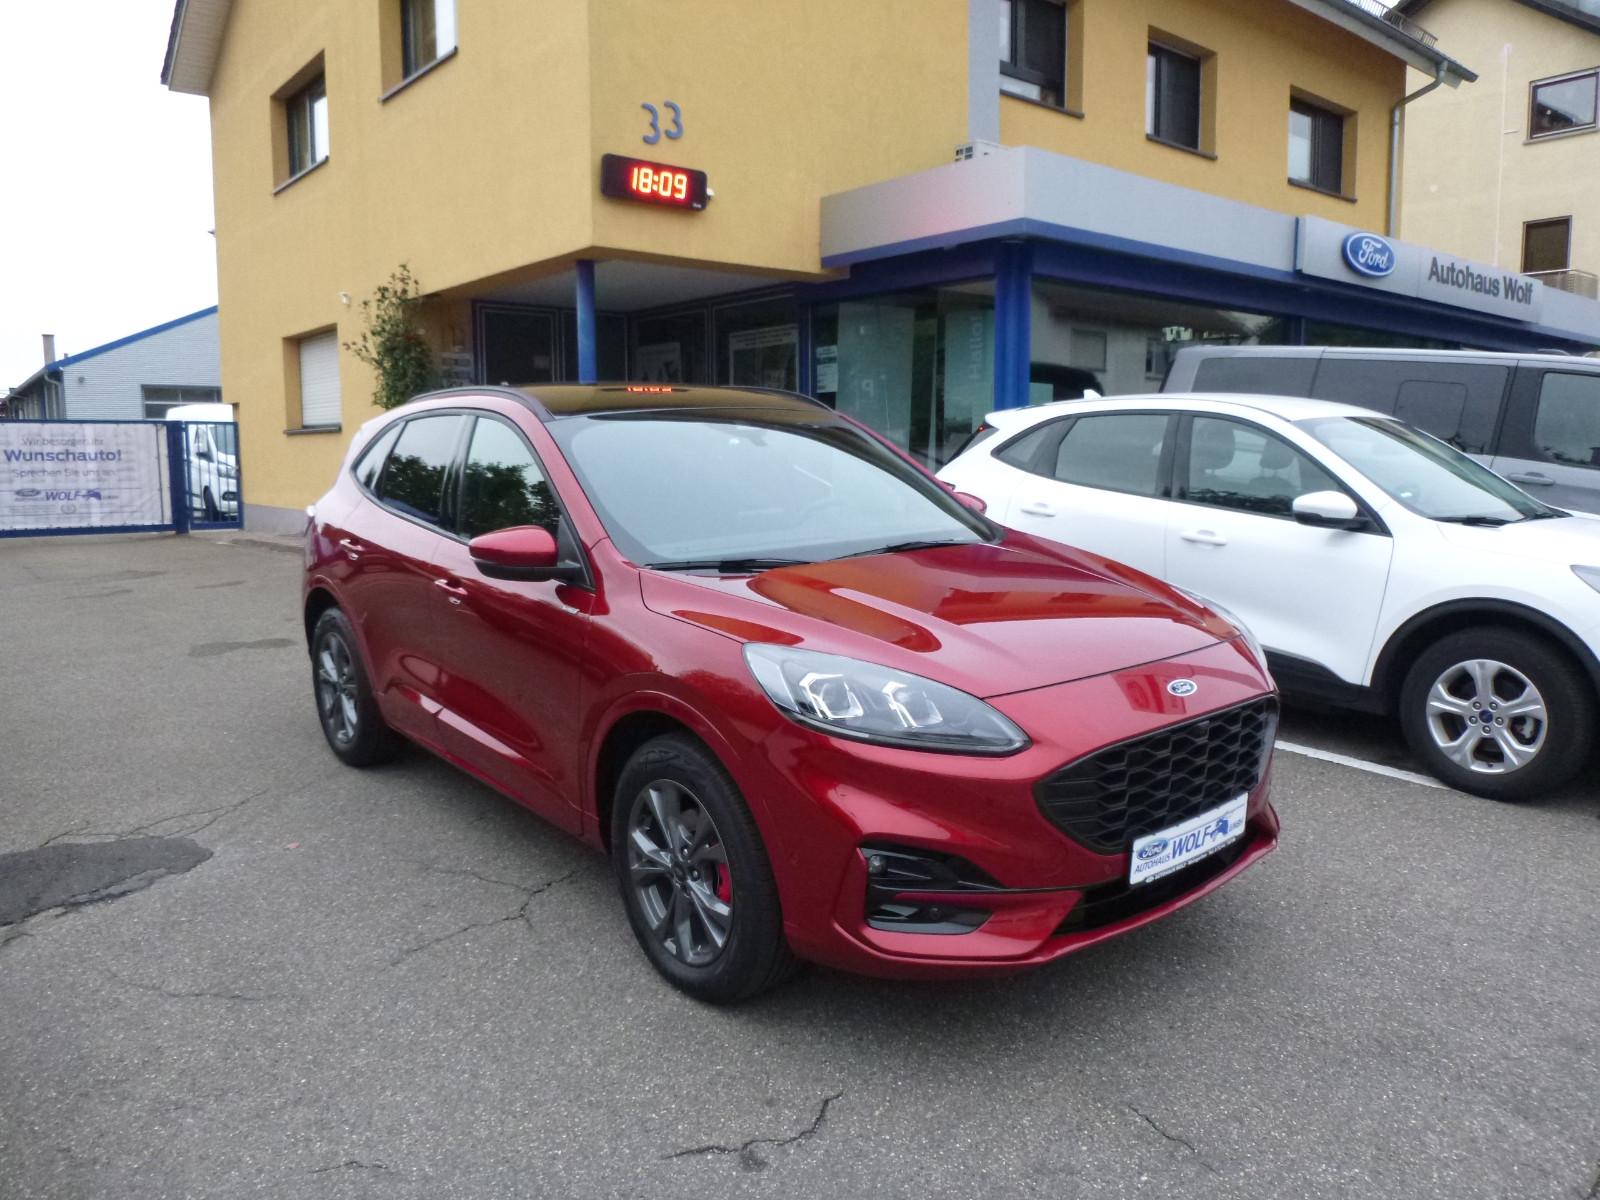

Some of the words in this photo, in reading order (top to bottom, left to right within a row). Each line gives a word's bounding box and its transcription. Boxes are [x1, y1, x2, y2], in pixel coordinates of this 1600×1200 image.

[641, 101, 684, 145] 33
[631, 167, 688, 200] 18:09
[1358, 238, 1390, 269] Ford
[1428, 256, 1500, 297] Autohaus
[1502, 275, 1534, 305] Wolf
[3, 449, 122, 462] Wunschauto!
[45, 490, 80, 501] WOLF
[1135, 852, 1171, 873] AUTOHAUS
[1172, 825, 1212, 859] WOLF
